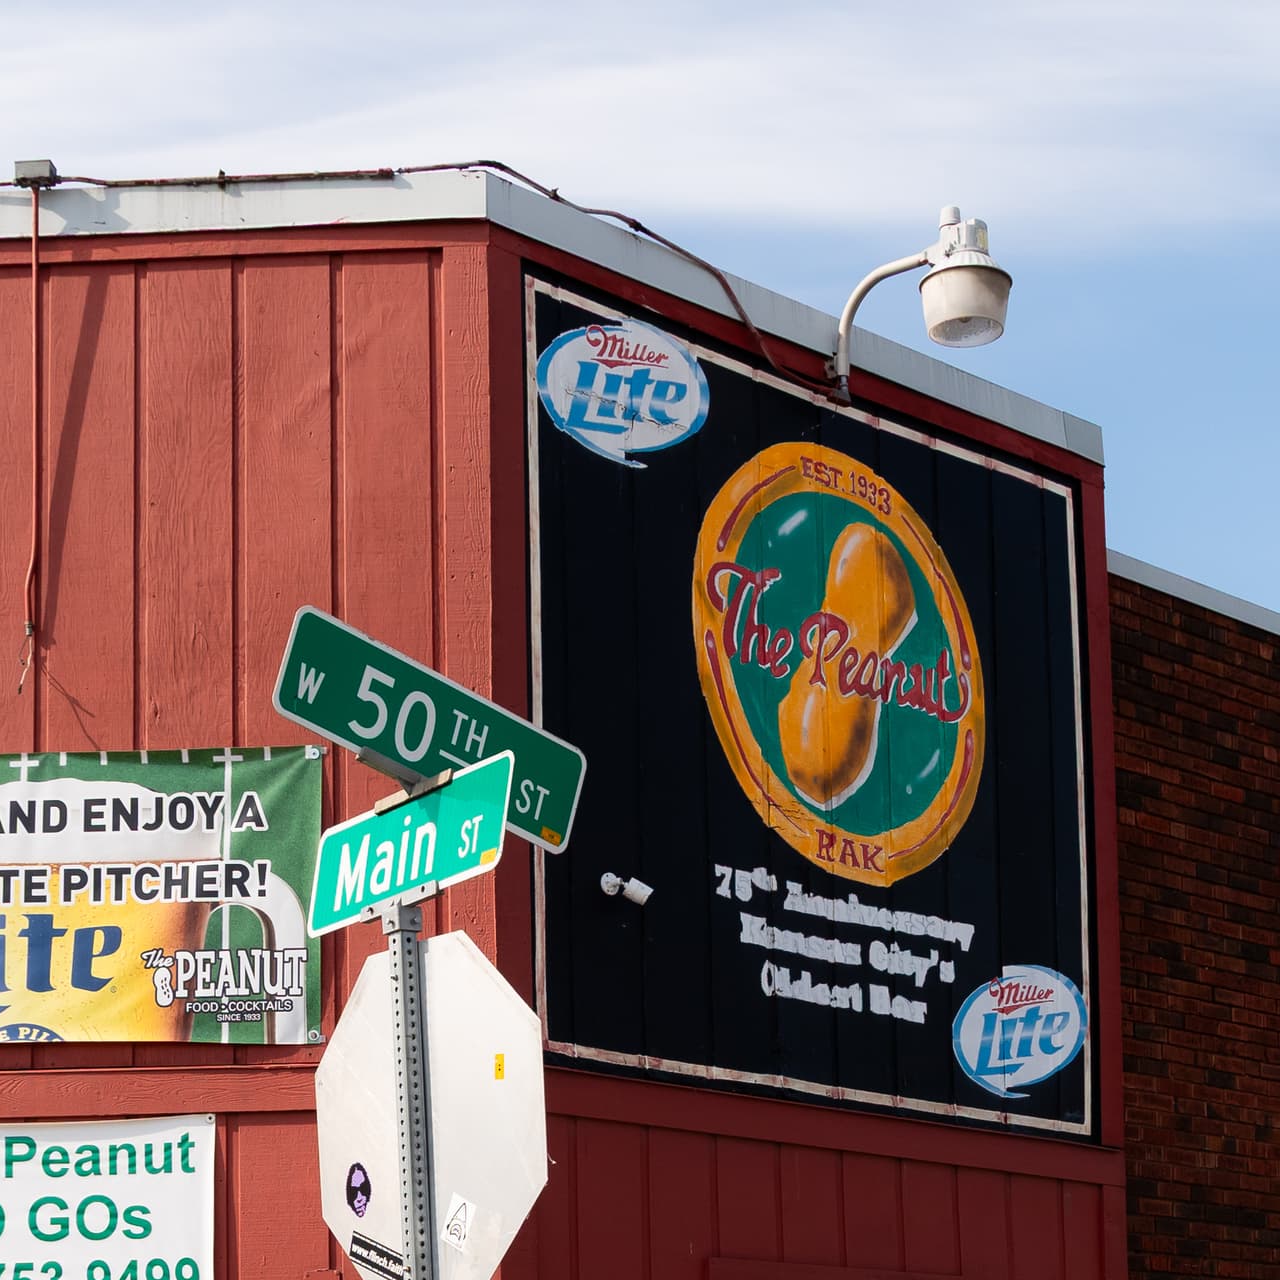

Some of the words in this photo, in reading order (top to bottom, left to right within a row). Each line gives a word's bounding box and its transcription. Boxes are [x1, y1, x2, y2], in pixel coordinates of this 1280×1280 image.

[586, 325, 669, 364] Miller
[564, 360, 688, 435] Lite
[706, 561, 782, 679] The
[799, 610, 972, 723] Peanut
[295, 661, 325, 705] W
[347, 664, 490, 763] 50TH
[515, 778, 551, 821] ST
[83, 794, 226, 832] ENJOY
[235, 794, 266, 829] A
[63, 862, 268, 904] PITCHER!
[332, 814, 437, 913] Main
[457, 814, 484, 860] ST
[739, 911, 863, 965] Kansas
[783, 880, 975, 952] Anniversary
[142, 948, 174, 968] The
[174, 948, 308, 998] PEANUT
[989, 976, 1055, 1007] Miller
[186, 1003, 219, 1013] FOOD
[228, 1000, 292, 1012] COCKTAILS
[217, 1013, 241, 1022] SINCE
[243, 1013, 262, 1022] 1933
[974, 1006, 1071, 1076] Lite
[3, 1130, 196, 1179] Peanut
[27, 1194, 154, 1243] GOs
